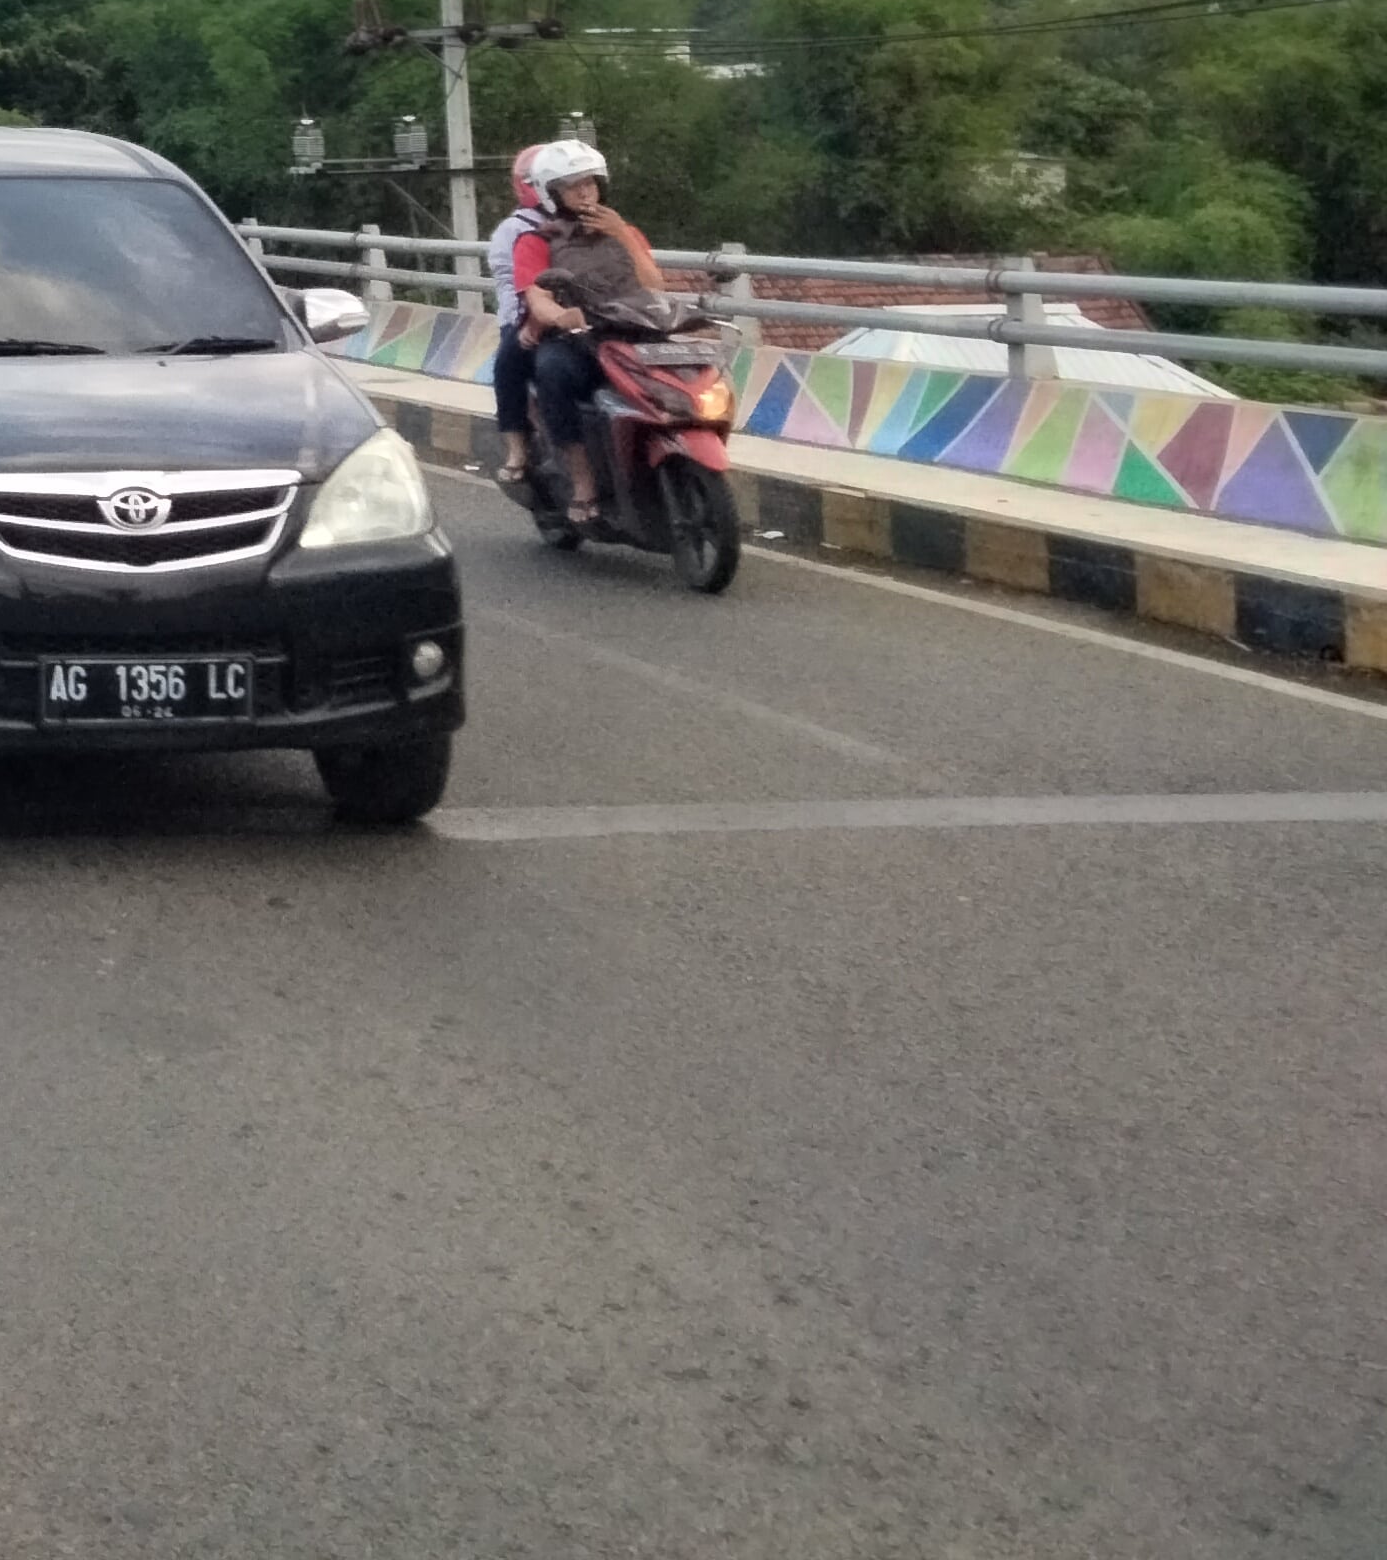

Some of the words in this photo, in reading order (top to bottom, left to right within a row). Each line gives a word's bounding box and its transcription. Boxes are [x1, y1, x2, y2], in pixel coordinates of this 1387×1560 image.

[49, 664, 88, 701] AG
[115, 664, 186, 702] 1356
[208, 663, 246, 700] LC
